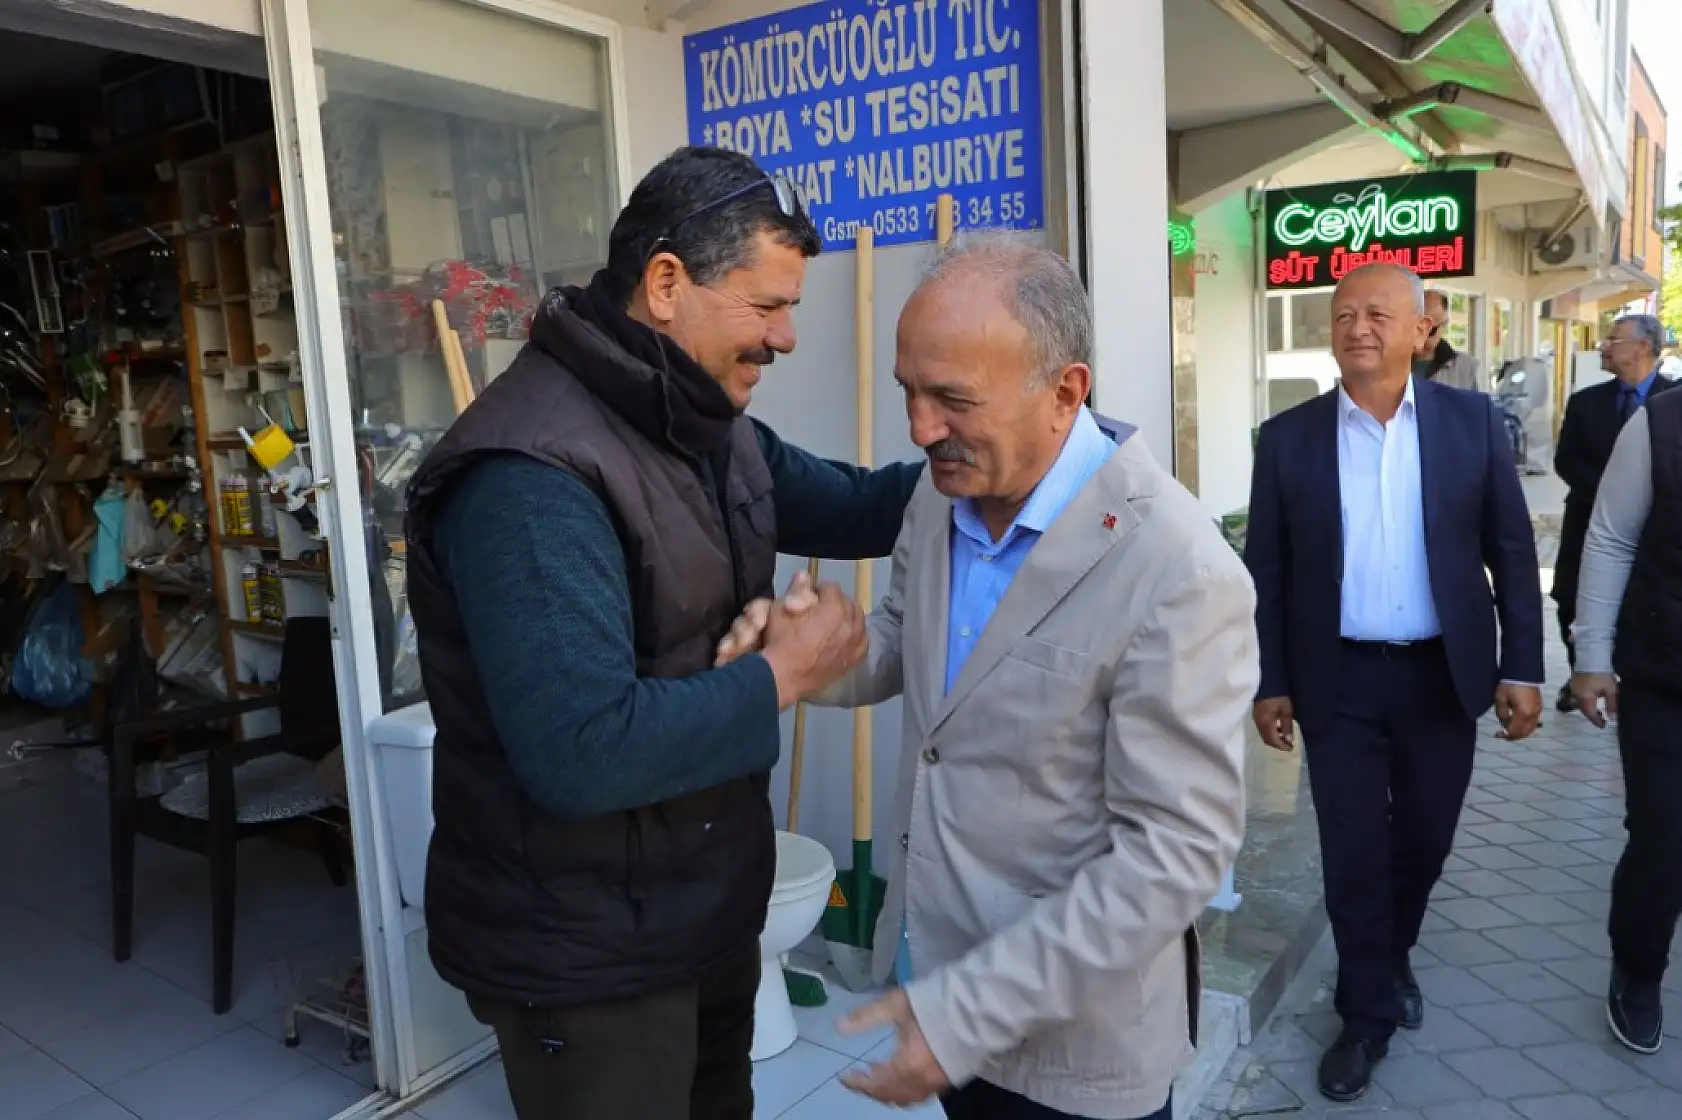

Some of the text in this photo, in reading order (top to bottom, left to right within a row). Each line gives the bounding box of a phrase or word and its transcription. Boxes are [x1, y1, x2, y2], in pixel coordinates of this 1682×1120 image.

[699, 0, 937, 112] KÖMÜRCÜOĞLU
[873, 204, 919, 236] 0533
[967, 195, 994, 226] 34
[1001, 191, 1025, 221] 55
[1273, 192, 1460, 252] Ceylan
[1269, 250, 1319, 284] SÜT
